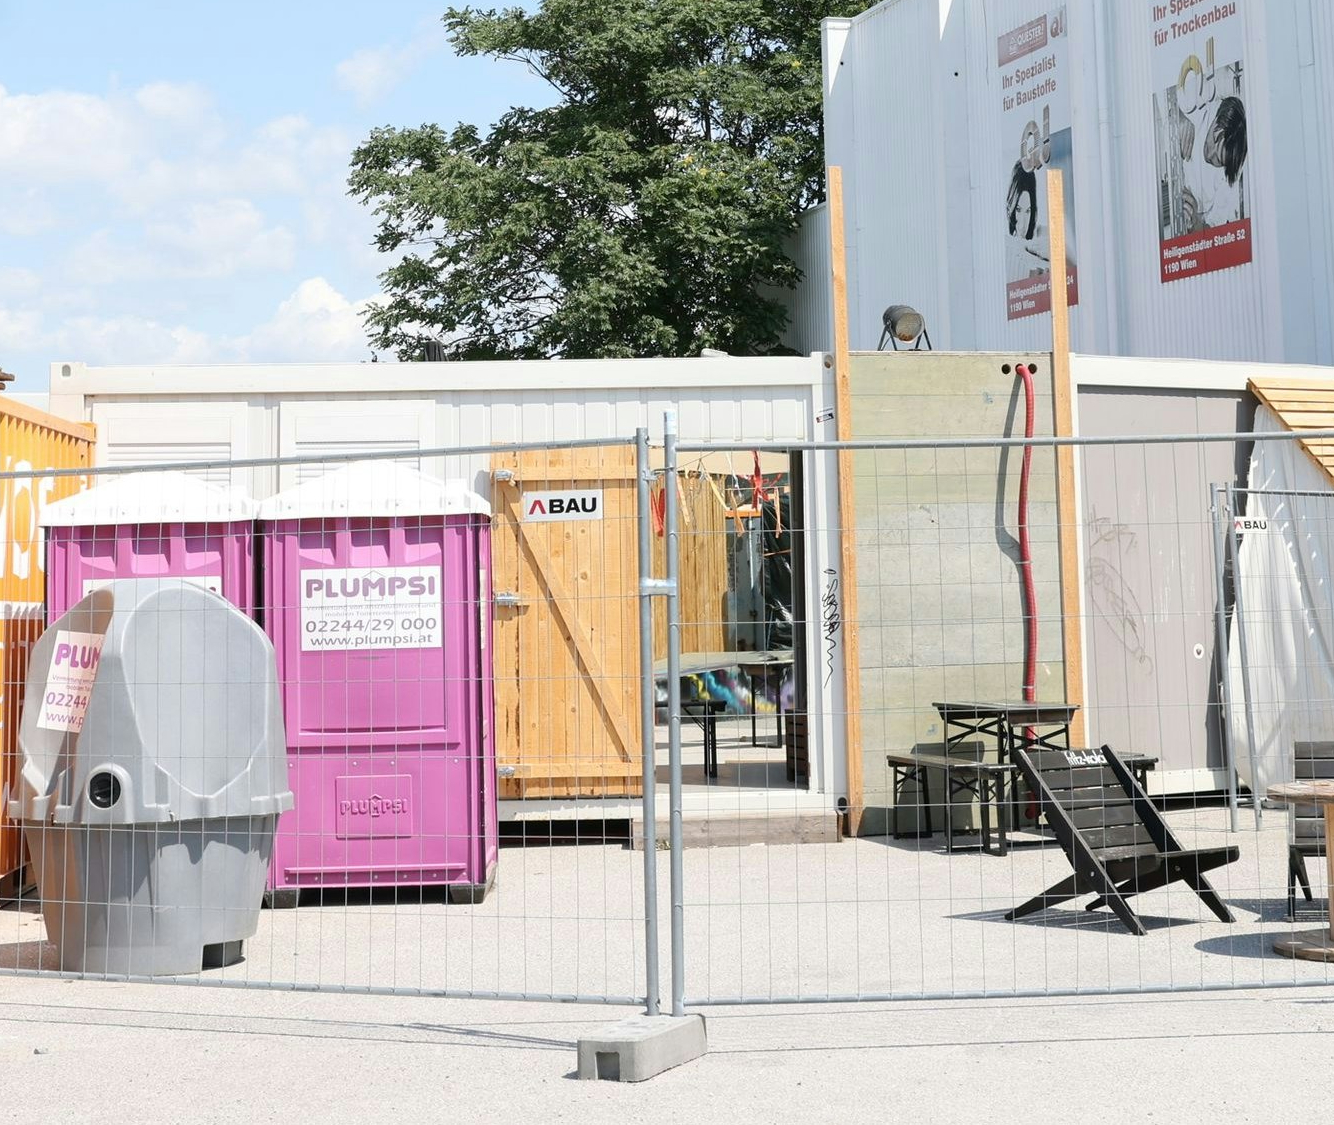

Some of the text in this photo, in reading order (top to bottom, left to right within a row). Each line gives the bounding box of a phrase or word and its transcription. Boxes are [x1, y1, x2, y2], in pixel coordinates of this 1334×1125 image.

[1153, 5, 1167, 22] Ihr
[1154, 2, 1236, 47] für Trockenbau
[1017, 23, 1044, 45] QUESTER!
[1002, 54, 1057, 90] Ihr Spezialist
[1003, 78, 1057, 112] für Baustoffe
[1163, 228, 1246, 259] Heiligenstädter Straße 52
[1164, 258, 1197, 274] 1190 Wien
[305, 576, 435, 599] PLUMPSI
[305, 617, 437, 633] 02244/29 000
[310, 633, 433, 647] www.plumpsi.at
[340, 798, 407, 815] PLUMPSI
